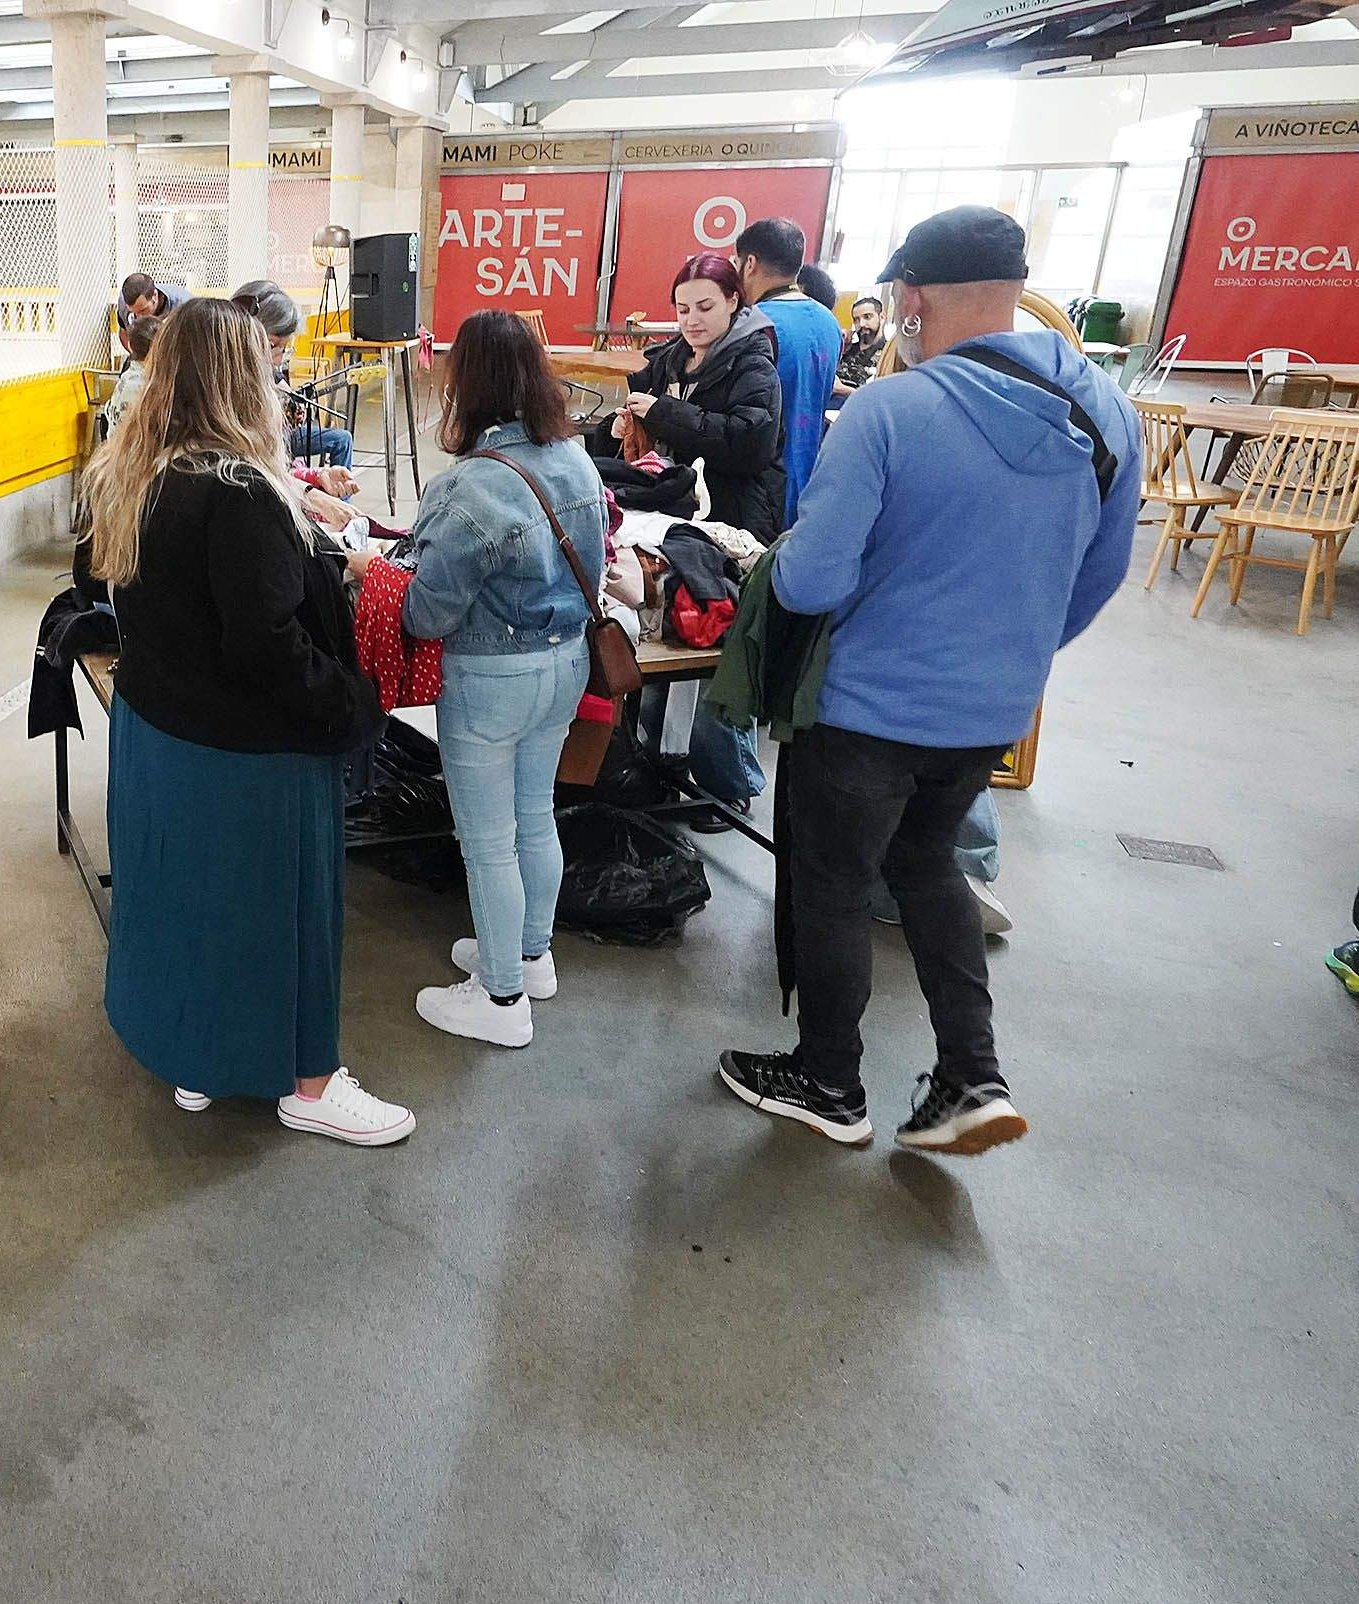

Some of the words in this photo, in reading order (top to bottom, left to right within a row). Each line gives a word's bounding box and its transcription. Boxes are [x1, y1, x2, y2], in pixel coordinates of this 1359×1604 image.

[1235, 124, 1249, 138] A
[1256, 119, 1359, 137] VIÑOTECA
[509, 142, 564, 161] POKE
[722, 143, 733, 156] O
[268, 151, 322, 168] MAMI
[439, 208, 583, 248] ARTE-
[1218, 245, 1359, 272] MERCA
[475, 246, 579, 297] SÁN
[1214, 277, 1257, 288] ESPAZO
